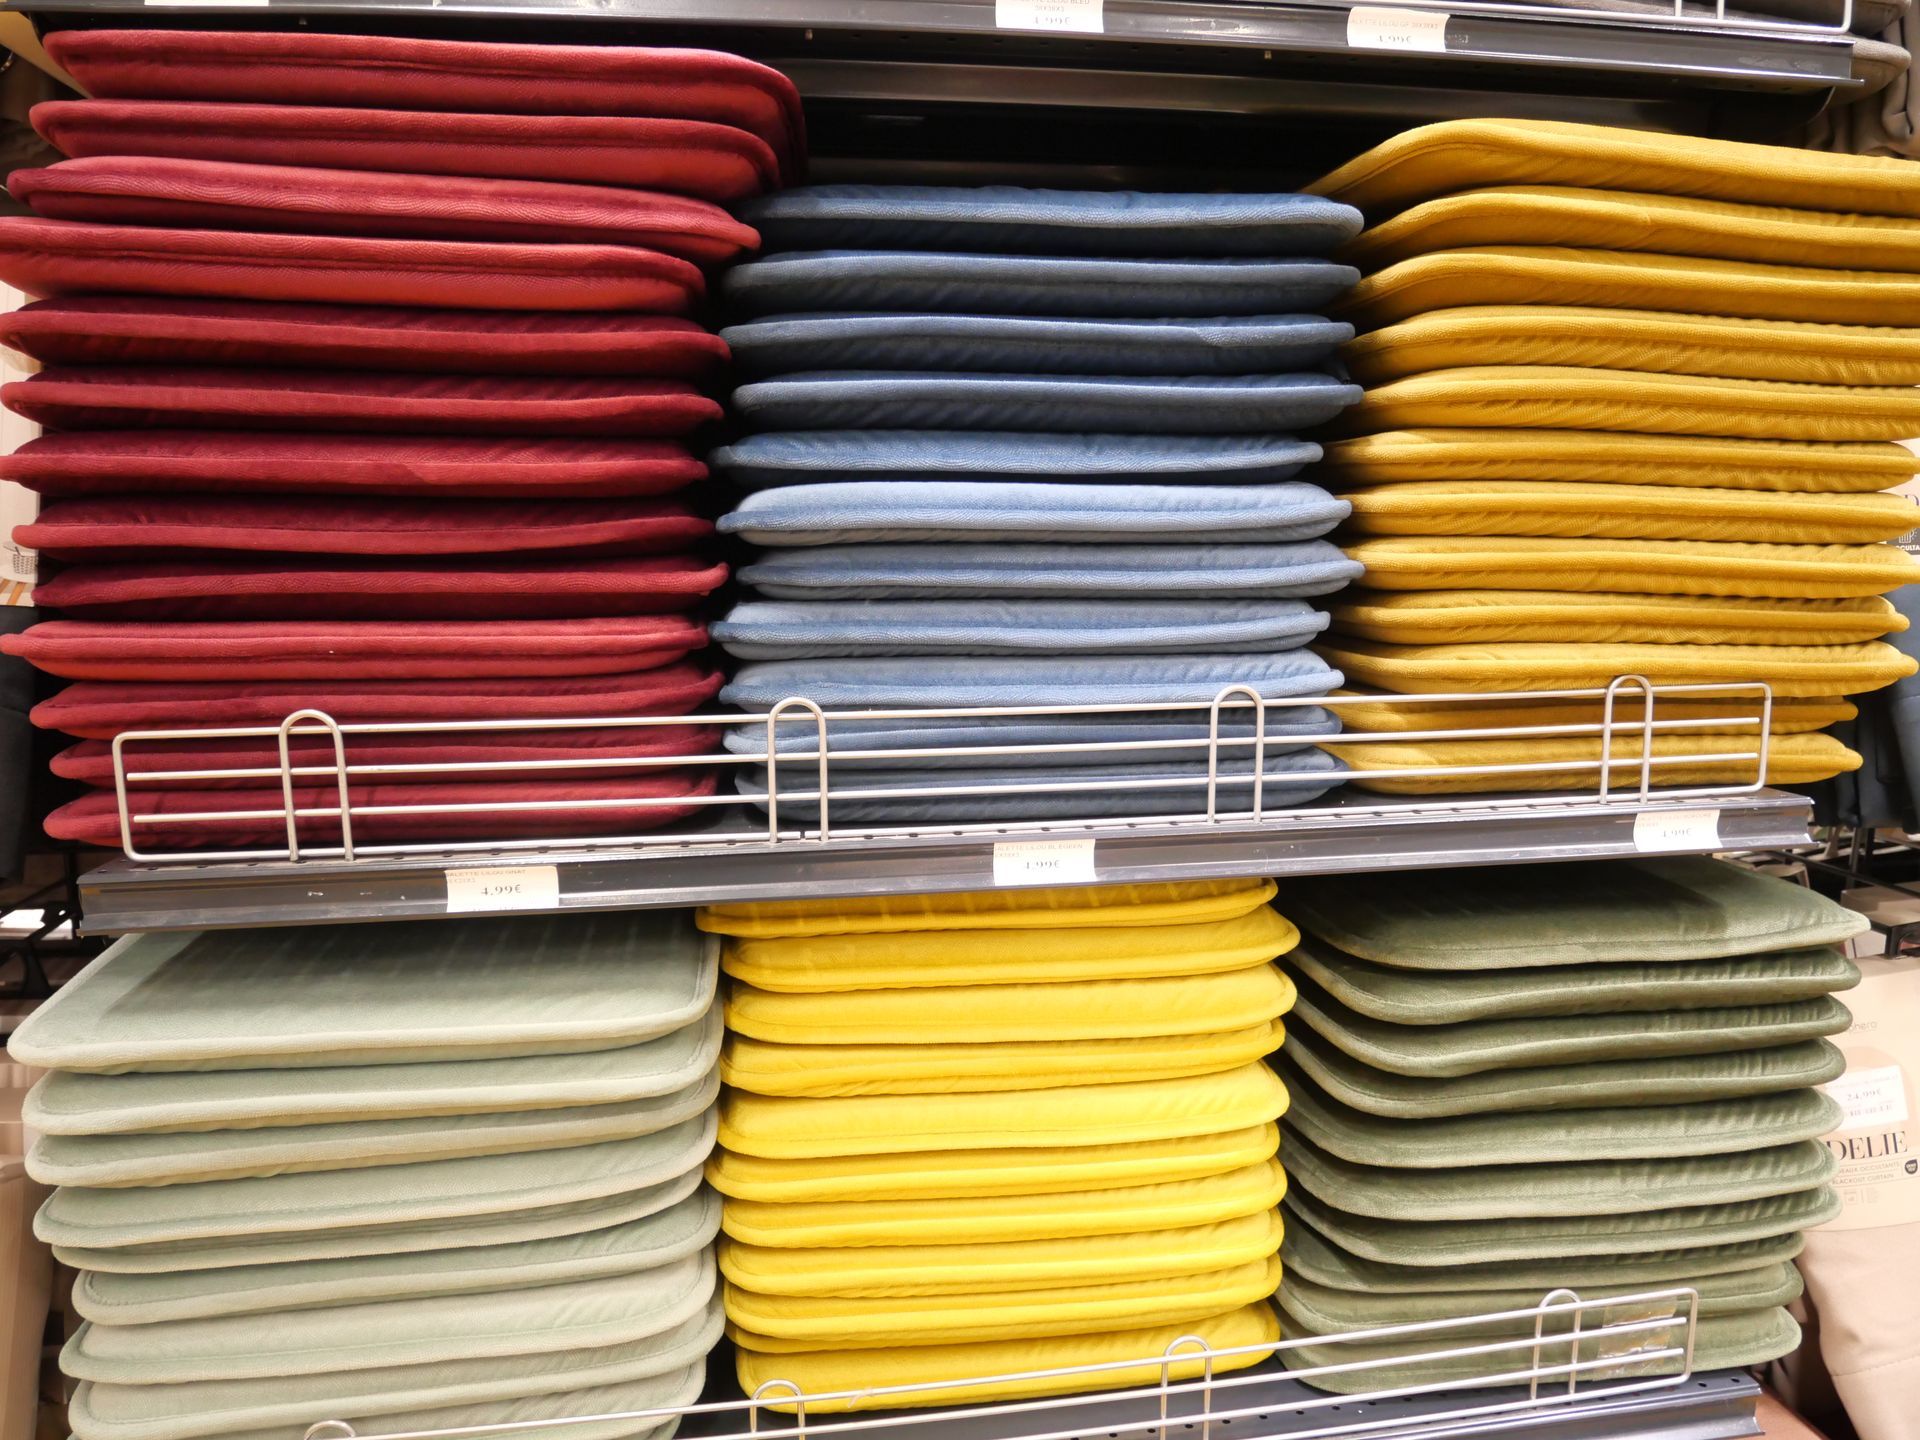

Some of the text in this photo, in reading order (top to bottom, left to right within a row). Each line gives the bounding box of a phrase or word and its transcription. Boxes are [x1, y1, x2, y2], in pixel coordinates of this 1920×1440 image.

[480, 884, 522, 896] 4.99€
[1860, 1161, 1901, 1172] OCCULTANTS
[1867, 1173, 1895, 1182] CURTAIN
